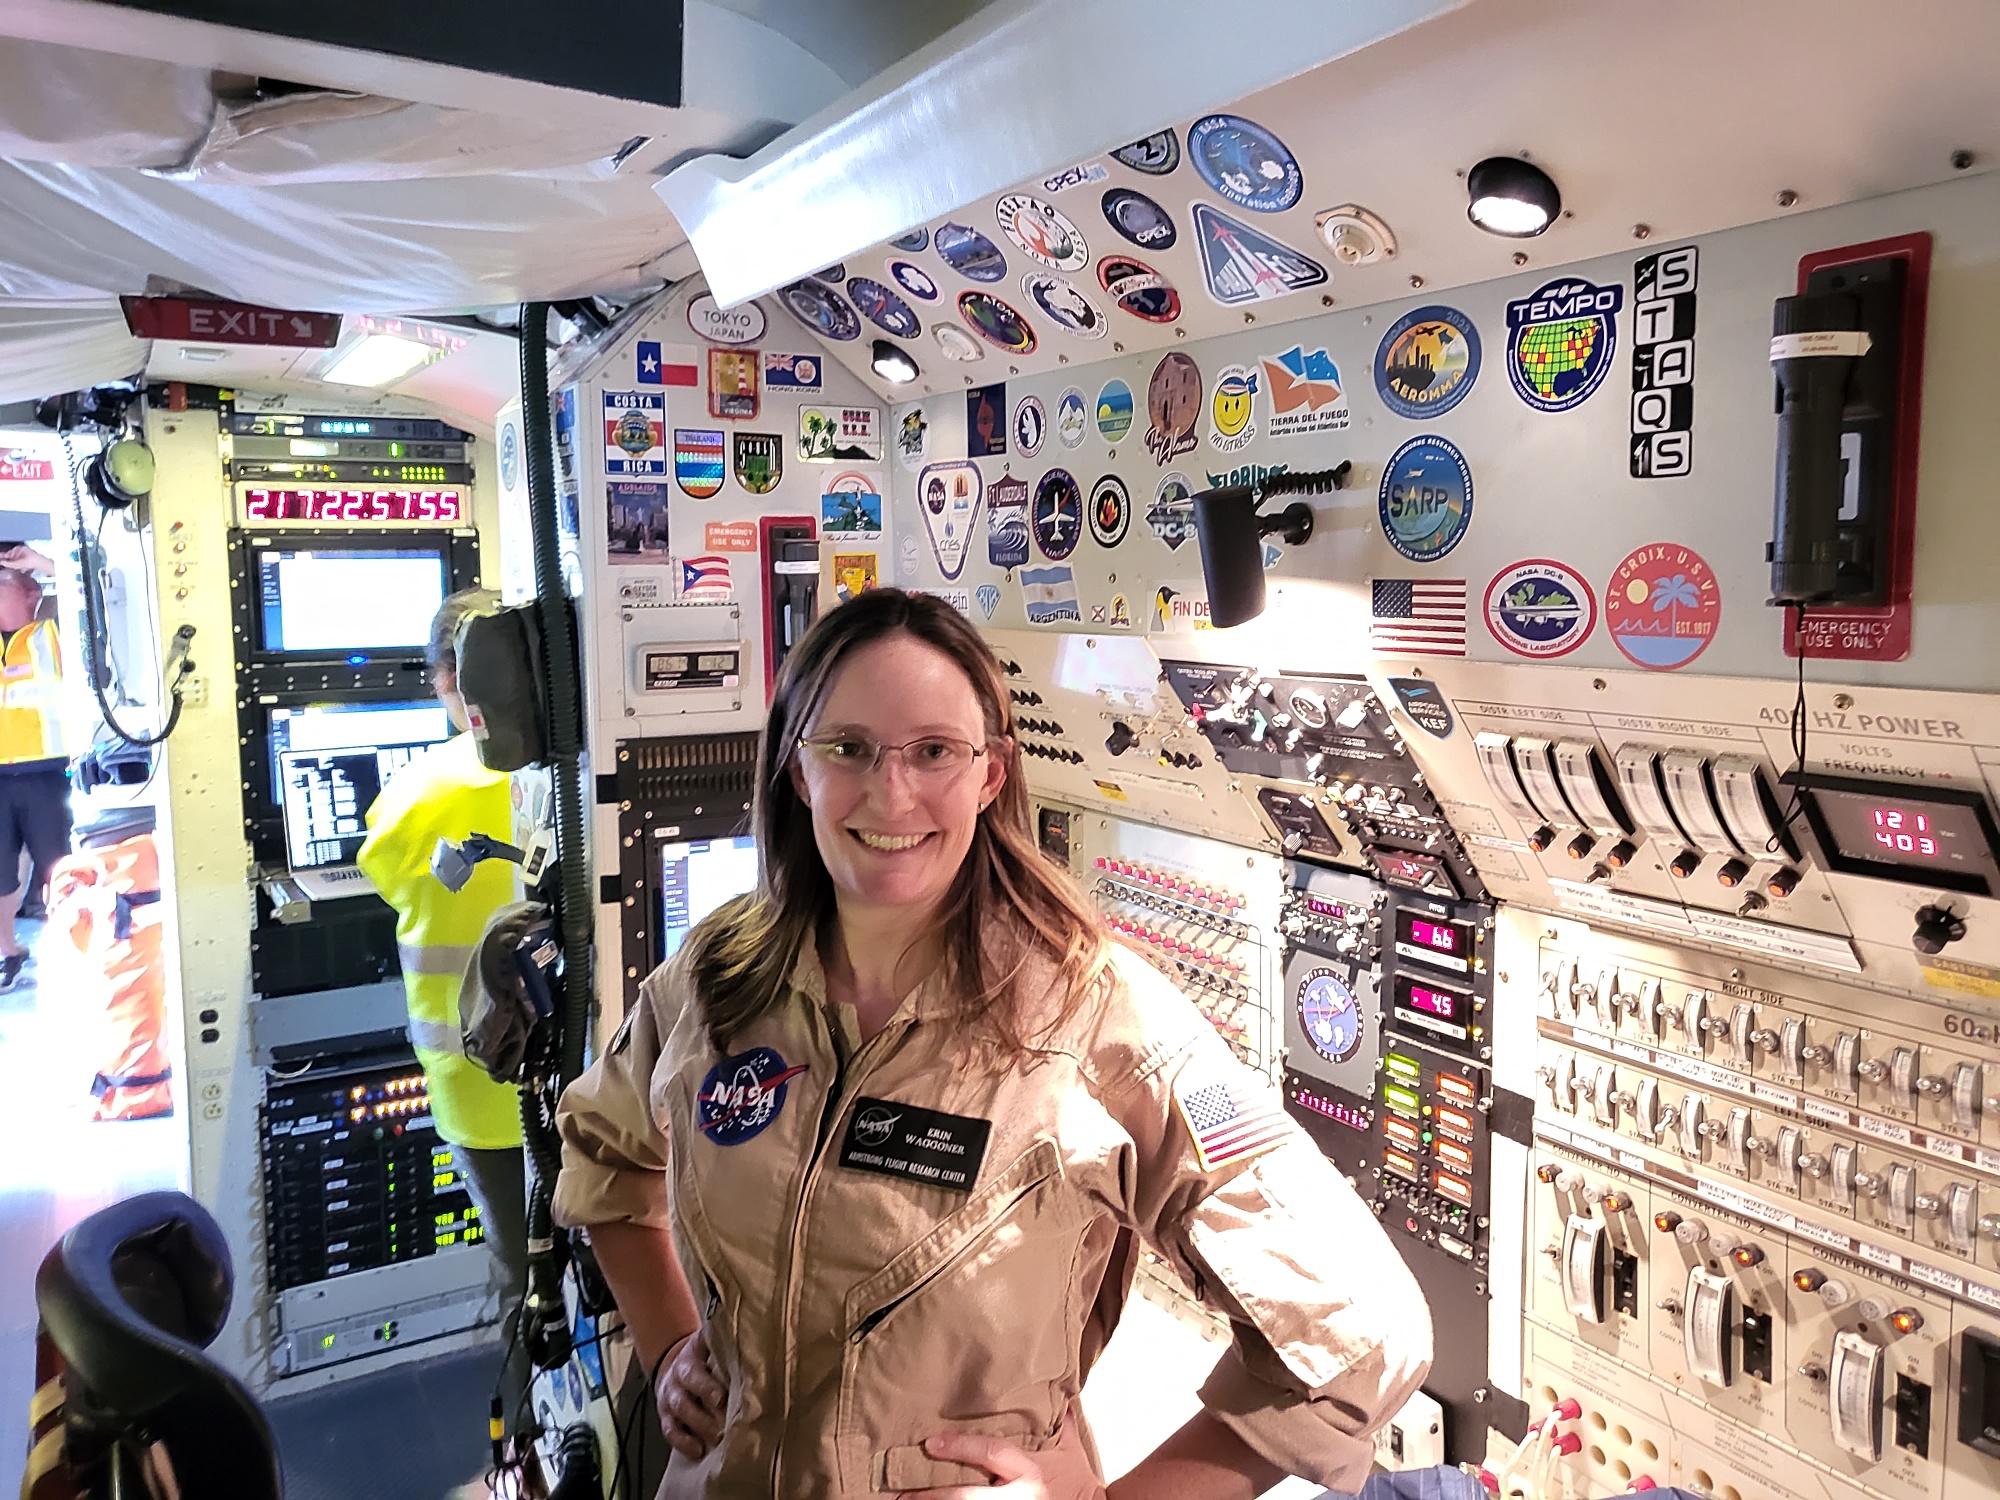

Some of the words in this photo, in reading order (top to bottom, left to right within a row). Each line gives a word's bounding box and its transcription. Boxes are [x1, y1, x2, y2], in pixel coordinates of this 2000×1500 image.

[1512, 291, 1615, 322] TEMPO
[189, 308, 284, 337] EXIT
[703, 311, 751, 327] TOKYO
[709, 327, 745, 340] JAPAN
[1390, 371, 1463, 403] AEROMMA
[614, 395, 653, 408] COSTA
[1270, 415, 1299, 427] TIERRA
[1301, 414, 1317, 423] DEL
[1320, 409, 1349, 420] FUEGO
[1222, 425, 1256, 452] STRESS
[1427, 438, 1460, 460] RESEARCH
[623, 461, 652, 473] RICA
[928, 492, 945, 501] NASA
[1391, 483, 1449, 518] SARP
[709, 527, 754, 536] EMERGENCY
[1153, 522, 1198, 539] DC-8
[995, 553, 1023, 562] FLORIDA
[1516, 568, 1539, 579] NASA
[1544, 569, 1564, 580] DC-8
[1608, 583, 1624, 610] ST.
[1620, 547, 1671, 579] CROIX,
[1029, 609, 1081, 624] ARGENTINA
[1173, 602, 1191, 616] FIN
[1494, 620, 1529, 649] AIRBORNE
[1530, 626, 1580, 651] LABORATORY
[1800, 621, 1892, 635] EMERGENCY
[1806, 635, 1834, 648] USE
[1842, 635, 1885, 649] ONLY
[1420, 716, 1448, 731] KEF
[1658, 721, 1697, 733] RIGHT
[1701, 725, 1733, 737] SIDE
[1812, 711, 1852, 730] HZ
[1857, 714, 1964, 739] POWER
[1840, 743, 1893, 758] VOLTS
[1823, 758, 1926, 779] FREQUENCY
[1875, 832, 1936, 855] 403
[1721, 983, 1755, 1001] RIGHT
[1760, 990, 1785, 1005] SIDE
[1944, 1014, 1975, 1037] 60
[1722, 1058, 1735, 1068] STA
[1771, 1074, 1785, 1084] STA
[709, 1081, 776, 1109] NASA
[1824, 1089, 1839, 1099] STA
[1774, 1105, 1800, 1120] LEFT
[1807, 1116, 1832, 1130] SIDE
[1880, 1105, 1896, 1116] STA
[927, 1127, 952, 1141] ERIN
[1940, 1123, 1957, 1134] STA
[905, 1134, 965, 1155] WAGGONER
[848, 1151, 884, 1166] ARMSTRONG
[884, 1157, 909, 1171] FLIGHT
[908, 1162, 941, 1178] RESEARCH
[941, 1169, 966, 1183] CENTER
[1717, 1162, 1731, 1172] STA
[1766, 1179, 1780, 1190] STA
[1670, 1191, 1730, 1221] CONVERTER
[1735, 1215, 1752, 1229] NO.
[1818, 1198, 1834, 1209] STA
[1874, 1219, 1890, 1229] STA
[1934, 1240, 1951, 1251] STA
[1812, 1246, 1885, 1284] CONVERTER
[1890, 1276, 1911, 1292] NO.
[1888, 1469, 1904, 1482] PWR
[1905, 1477, 1930, 1493] DISTR
